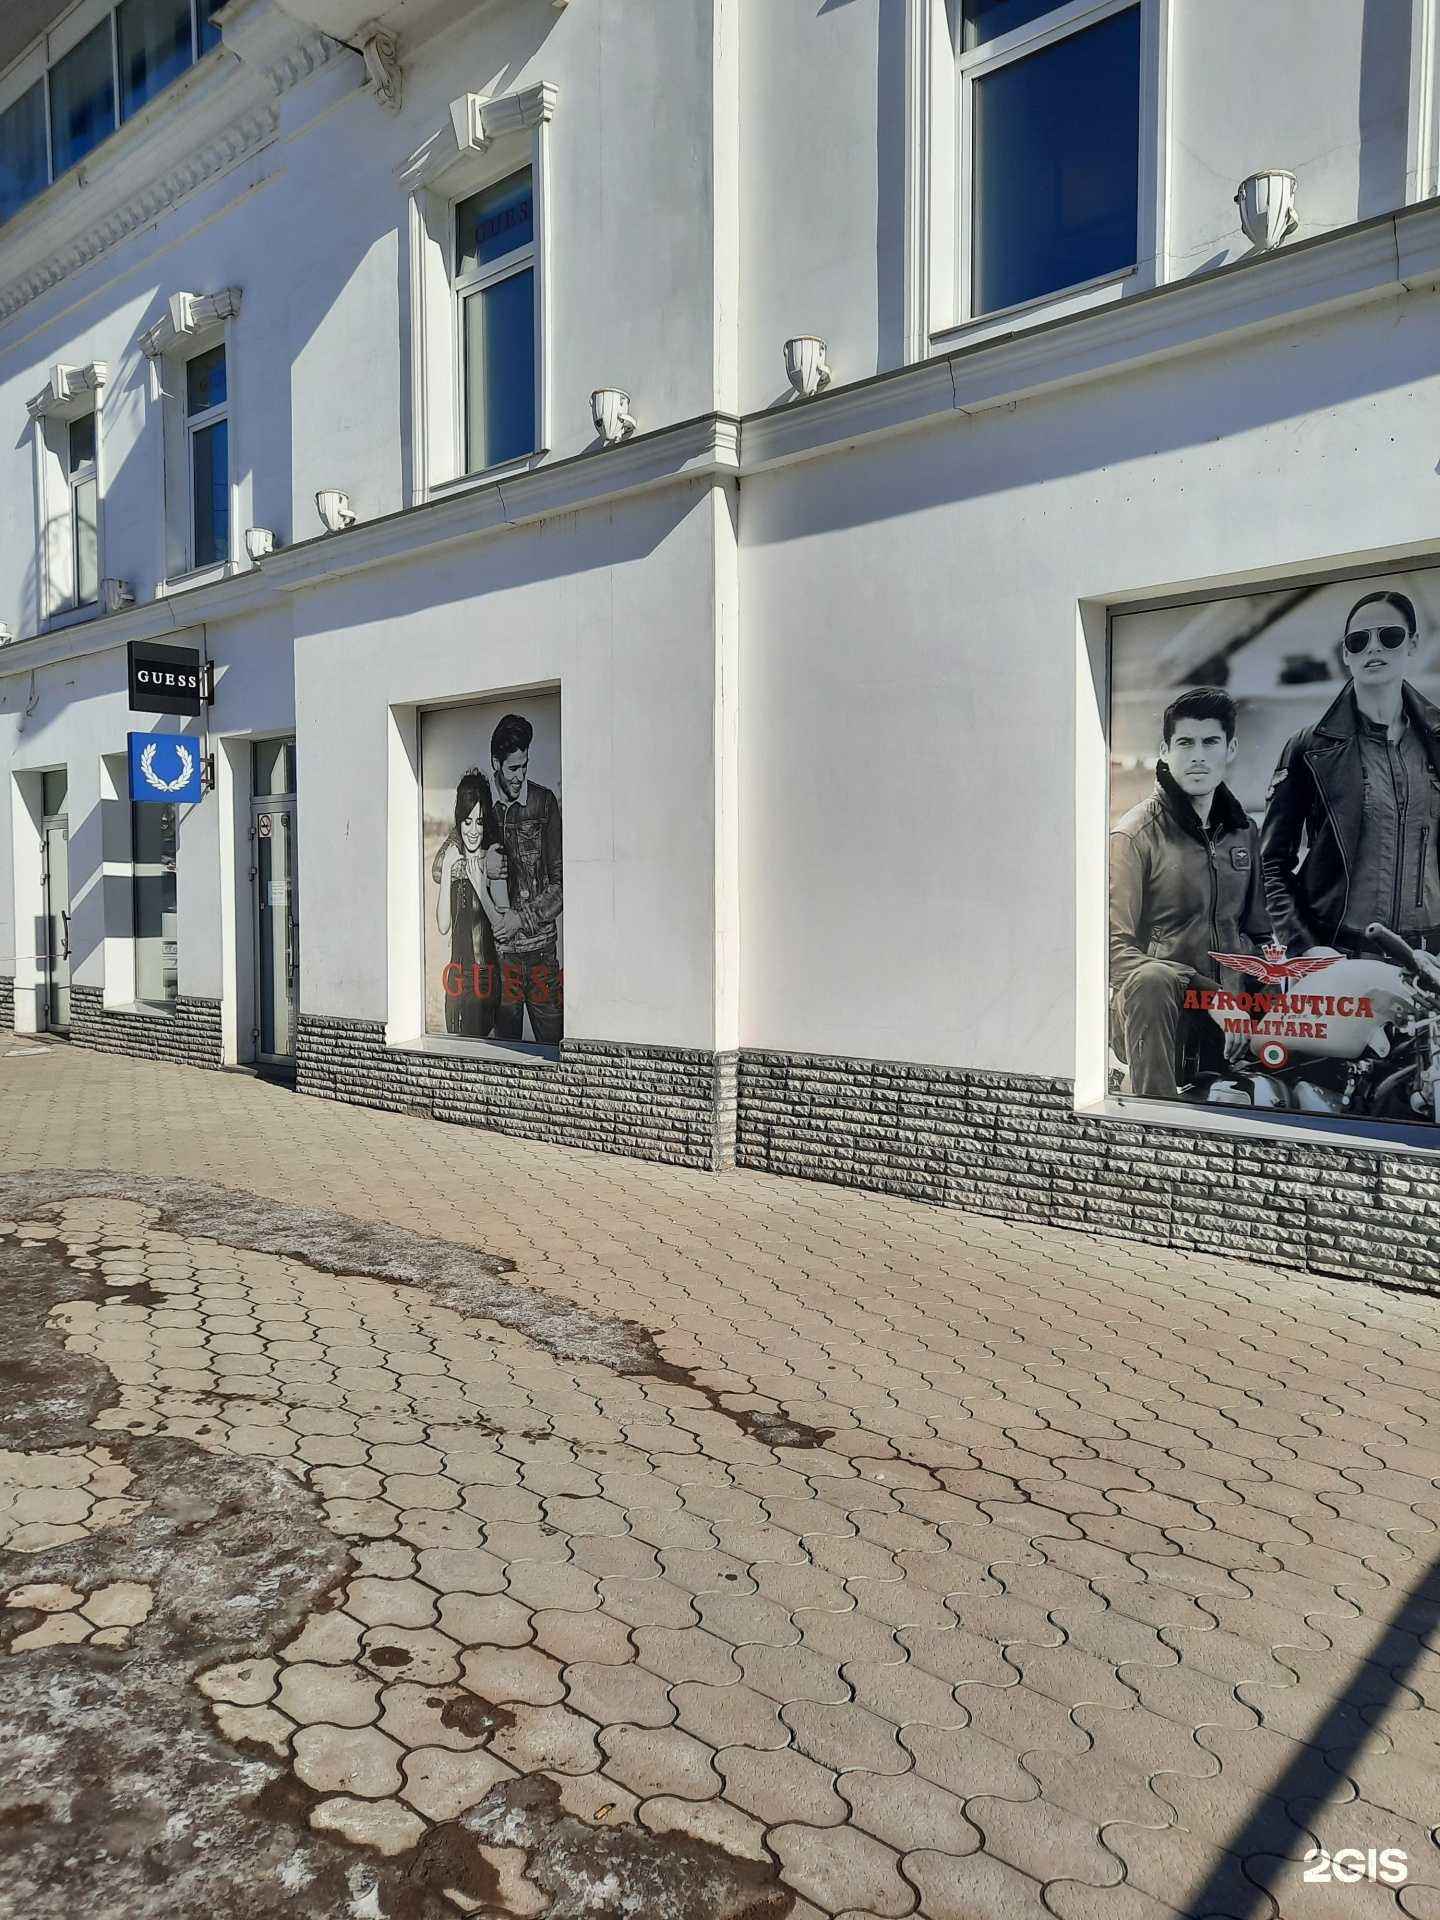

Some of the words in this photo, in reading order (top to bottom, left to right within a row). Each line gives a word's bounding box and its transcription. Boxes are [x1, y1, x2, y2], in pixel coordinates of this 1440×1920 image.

[137, 670, 197, 688] GUESS
[442, 961, 564, 1009] GUES
[1183, 988, 1375, 1019] AERONAUTICA
[1223, 1017, 1328, 1040] MILITARE
